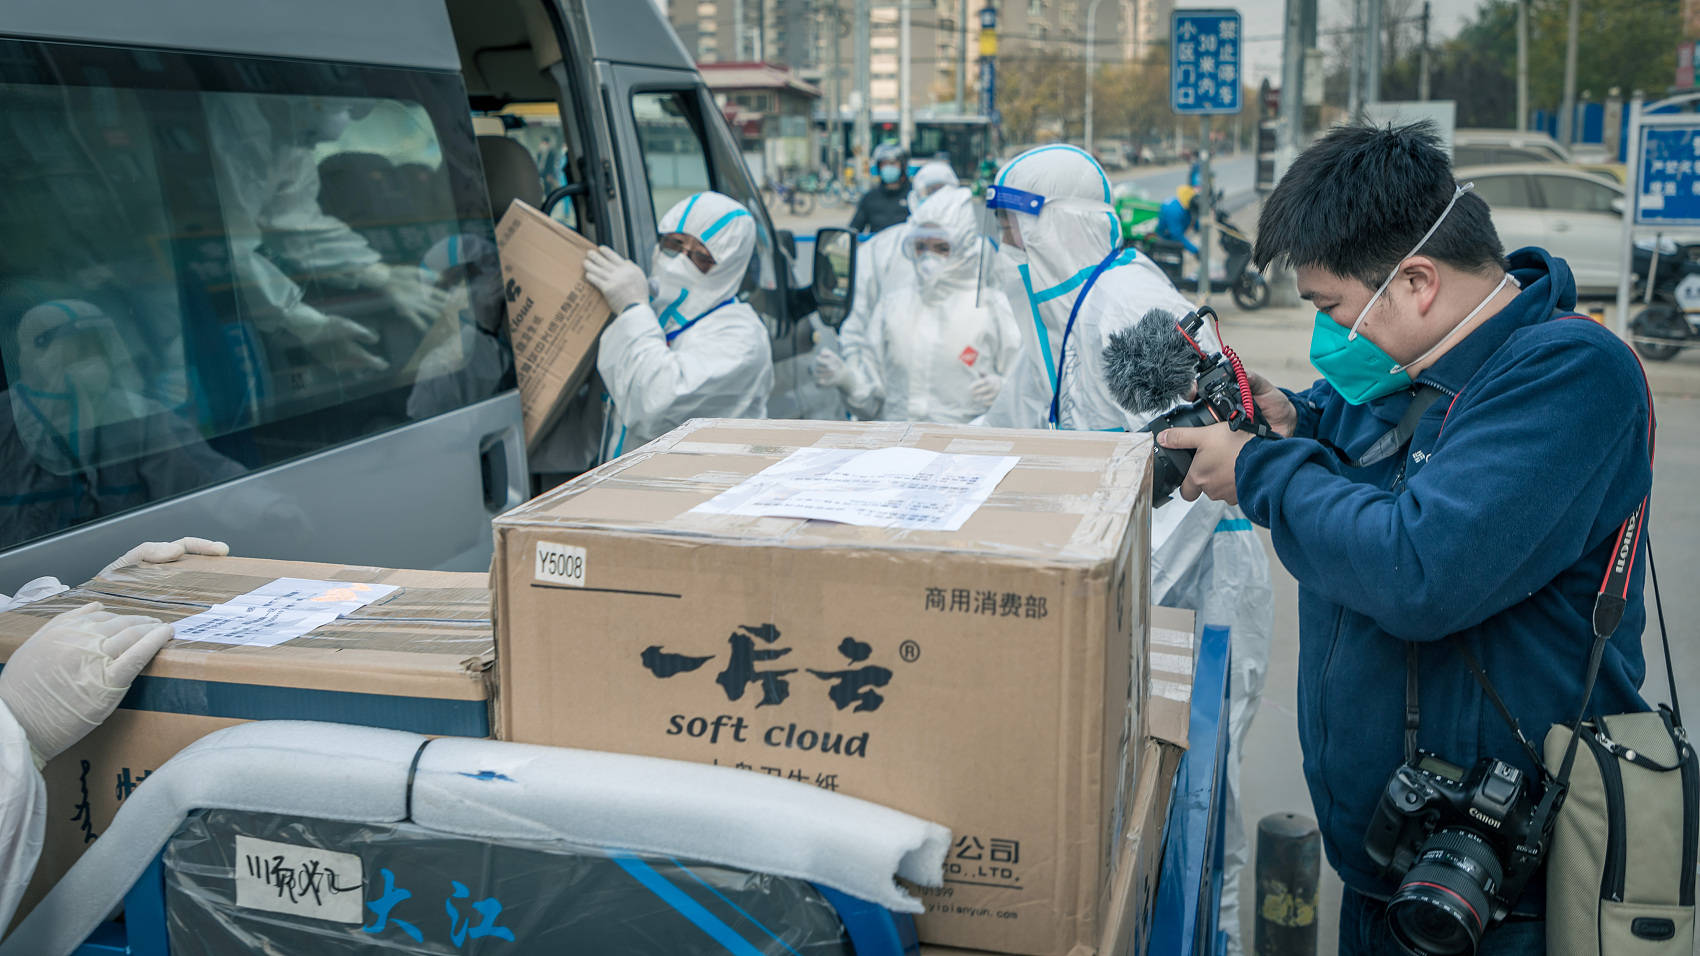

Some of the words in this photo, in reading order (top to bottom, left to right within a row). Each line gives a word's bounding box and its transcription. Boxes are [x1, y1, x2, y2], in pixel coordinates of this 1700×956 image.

[539, 550, 582, 579] Y5008
[924, 586, 1048, 619] 商用消费部
[666, 714, 748, 743] soft
[763, 723, 870, 758] cloud
[1468, 807, 1502, 830] Canon
[363, 868, 516, 948] 大江
